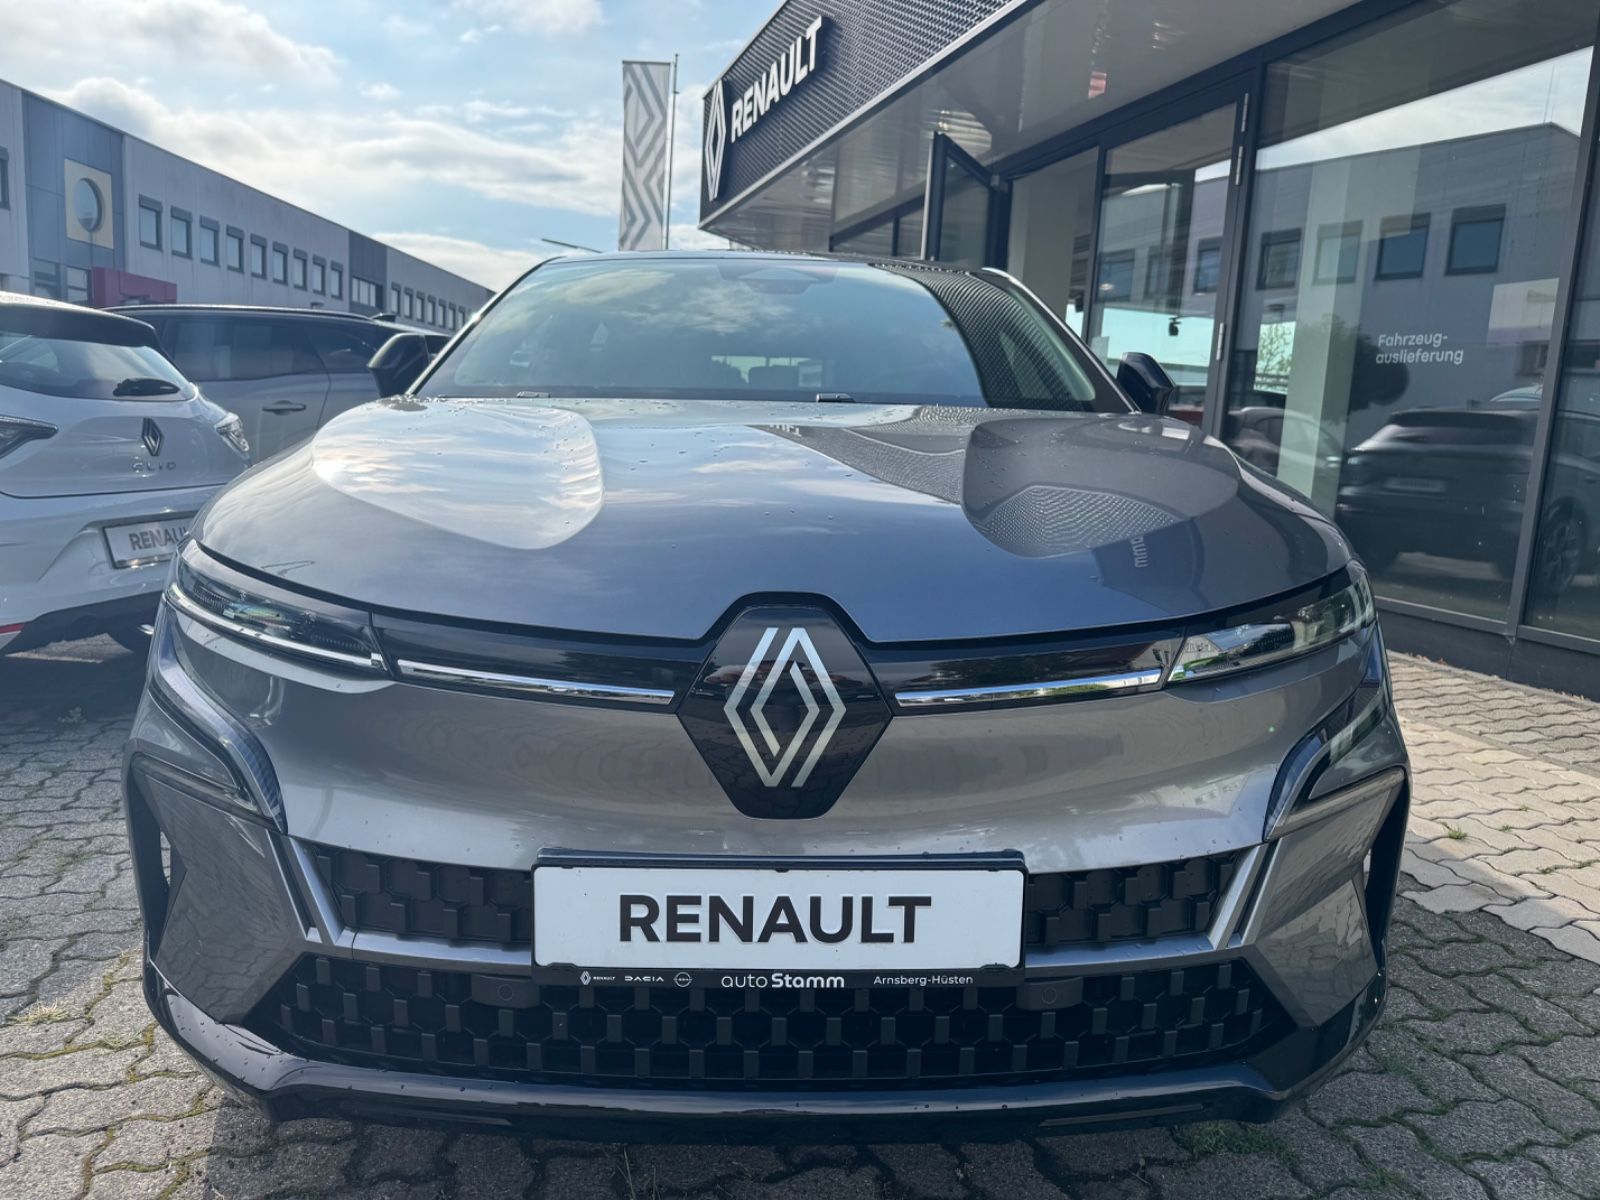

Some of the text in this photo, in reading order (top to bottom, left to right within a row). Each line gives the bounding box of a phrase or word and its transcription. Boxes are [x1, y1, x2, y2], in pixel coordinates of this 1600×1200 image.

[731, 15, 822, 143] RENAULT
[1377, 332, 1448, 348] Fahrzeug-
[1375, 348, 1464, 365] auslieferung
[619, 894, 932, 944] RENAULT
[873, 975, 974, 987] Arnsberg-Hüsten
